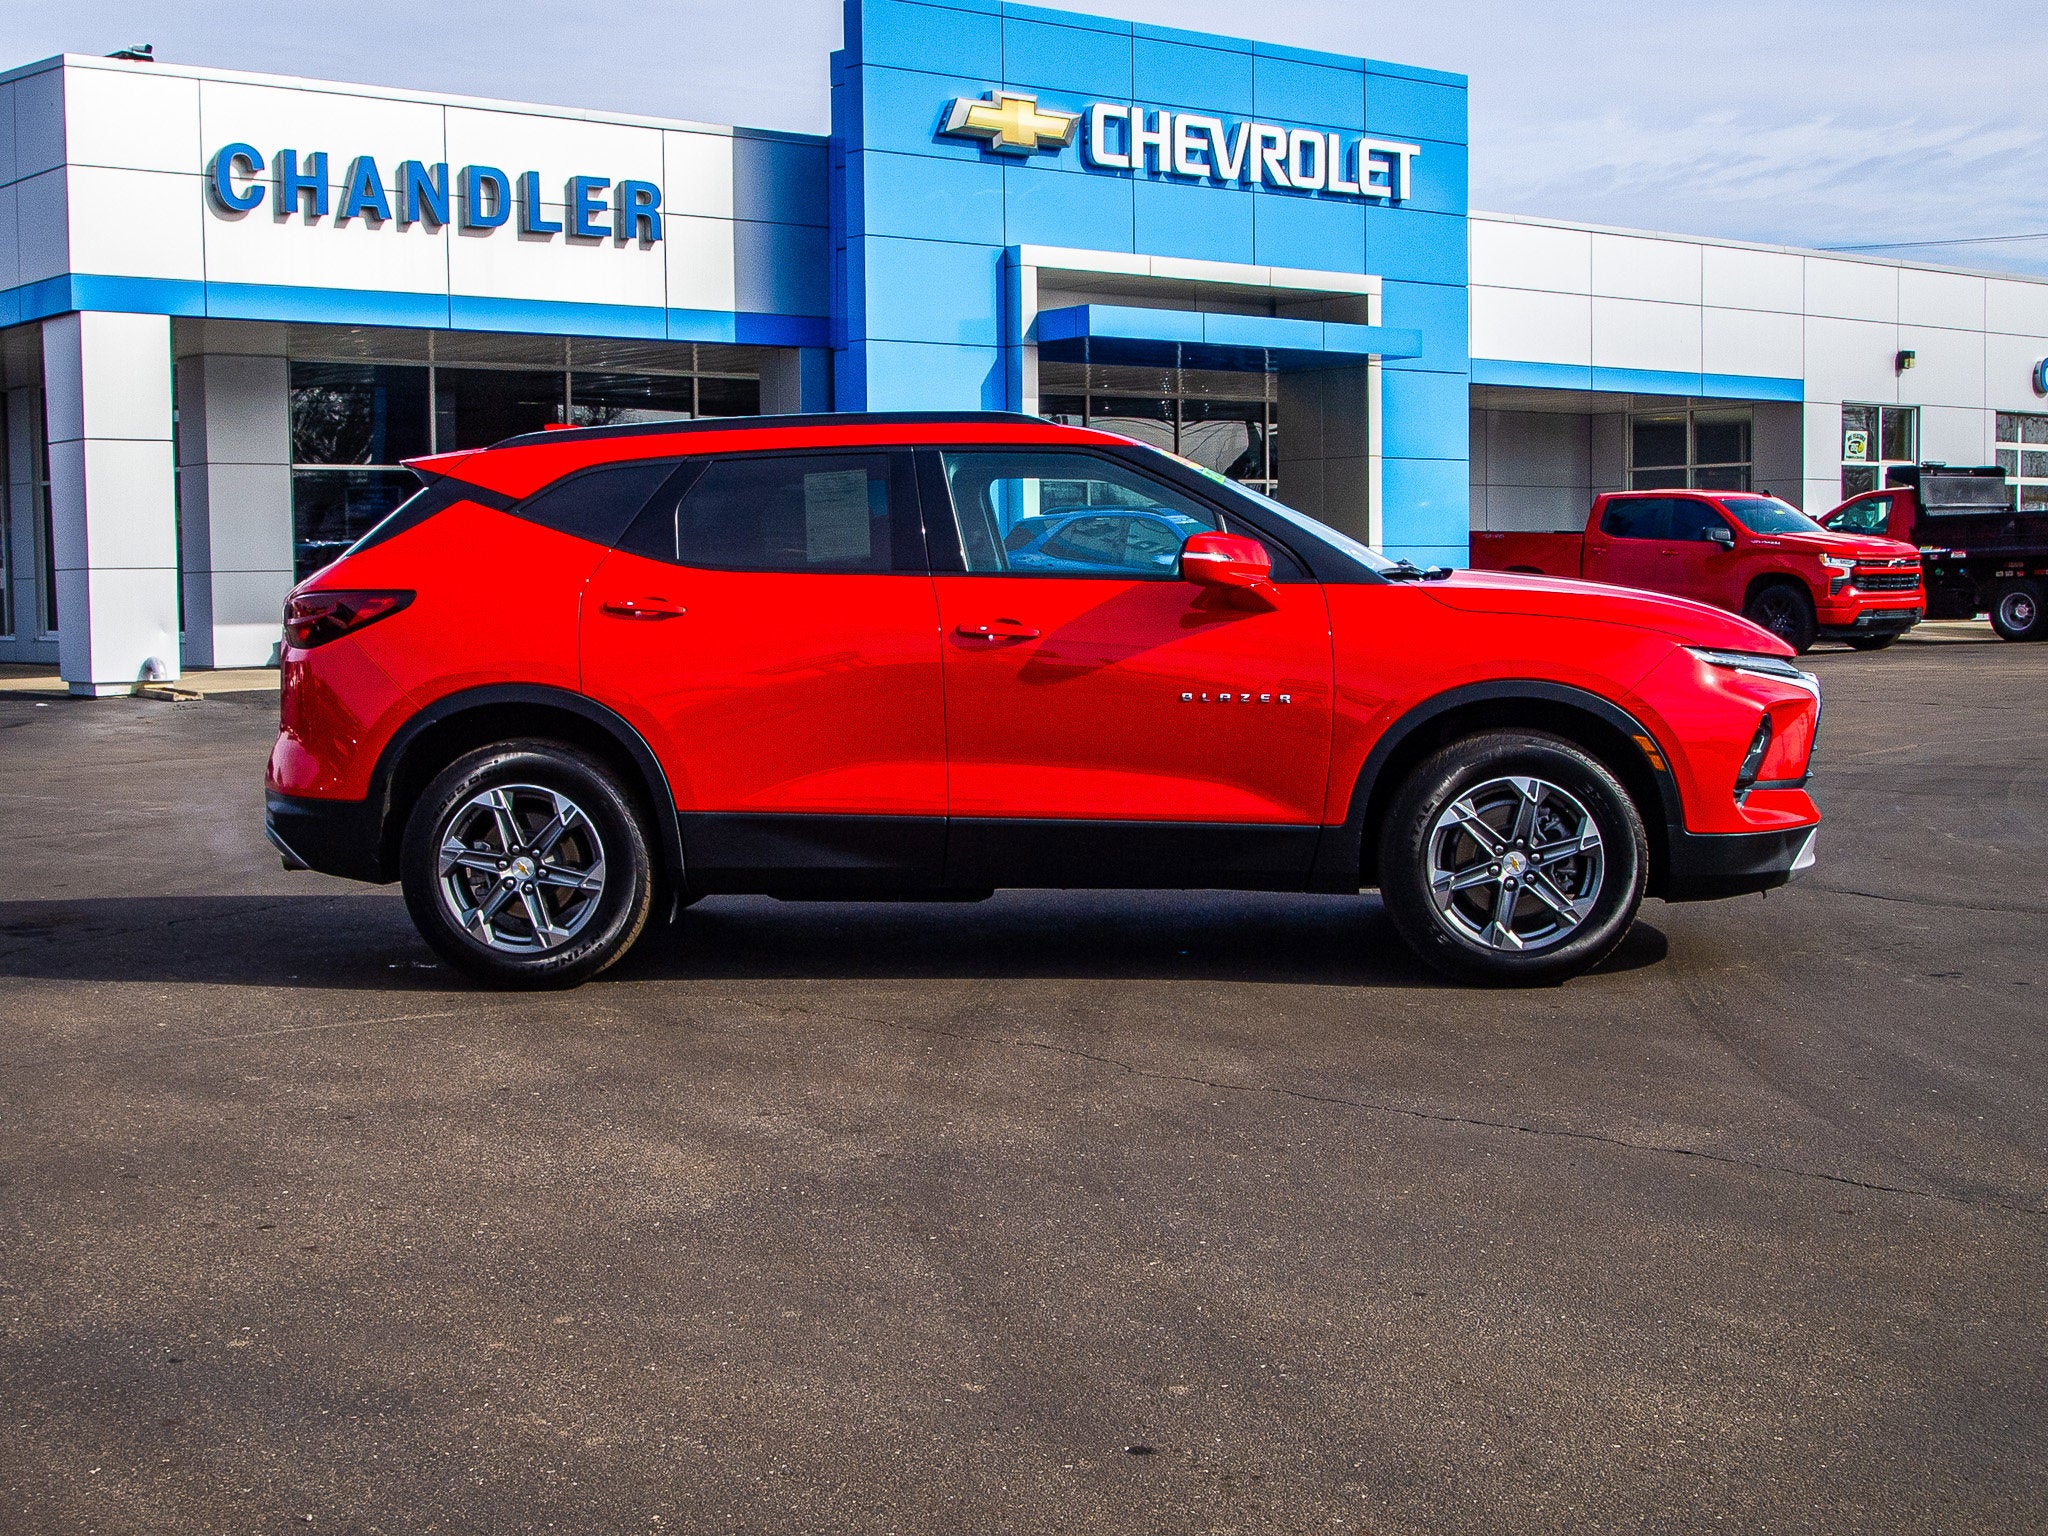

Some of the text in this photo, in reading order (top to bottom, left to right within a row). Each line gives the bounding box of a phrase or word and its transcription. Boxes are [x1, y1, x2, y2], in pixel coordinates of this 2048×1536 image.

[211, 142, 664, 243] CHANDLER
[1087, 102, 1421, 202] CHEVROLET
[1181, 693, 1291, 704] BLAZER
